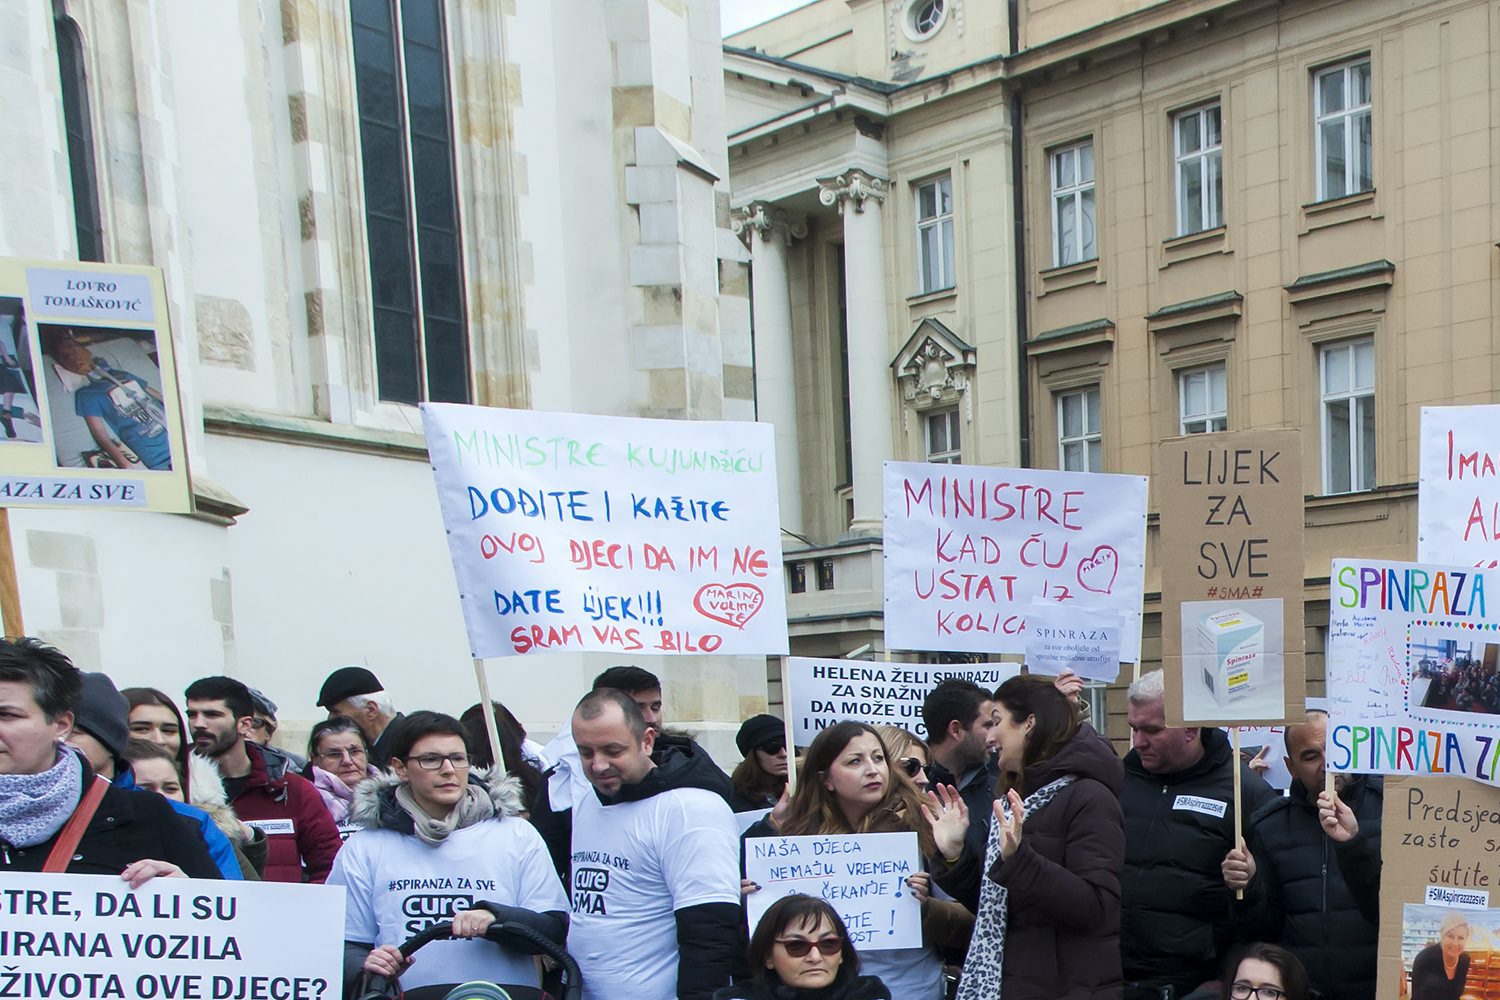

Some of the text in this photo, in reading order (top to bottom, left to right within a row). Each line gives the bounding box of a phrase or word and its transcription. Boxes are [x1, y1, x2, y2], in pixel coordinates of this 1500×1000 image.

[67, 279, 118, 293] LOVRO
[44, 295, 143, 312] TOMAŠKOVIĆ
[453, 430, 609, 467] MINISTRE
[1183, 449, 1281, 486] LIJEK
[51, 483, 85, 499] ZA
[90, 484, 135, 501] SVE
[904, 475, 1085, 531] MINISTRE
[631, 494, 732, 522] KAŽITE
[1205, 494, 1252, 526] ZA
[480, 533, 769, 577] OVOJ DJECI DA IM NE
[936, 527, 1000, 565] KAD
[1197, 538, 1269, 580] SVE
[914, 569, 1076, 603] USTAT IZ
[1207, 585, 1264, 600] #SMA#
[1338, 566, 1486, 618] SPINRAZA
[493, 590, 565, 615] DATE
[510, 624, 723, 654] SRAM VAS BILO
[1036, 628, 1108, 641] SPINRAZA
[813, 666, 887, 682] HELENA
[891, 668, 928, 684] ŽELI
[831, 684, 855, 697] ZA
[811, 700, 836, 714] DA
[841, 701, 895, 717] MOŽE
[1332, 725, 1466, 775] SPINRAZA
[755, 838, 862, 858] NAŠA DJECA
[1401, 826, 1460, 849] zašto
[602, 854, 611, 865] ZA
[614, 857, 629, 870] SVE
[770, 860, 910, 880] NEMAJU VREMENA
[1429, 860, 1489, 887] šutite
[388, 878, 496, 891] #SPIRANZA ZA SVE
[576, 869, 607, 889] cure
[95, 891, 237, 921] DA LI SU
[405, 897, 470, 916] cure
[573, 892, 607, 915] SMA
[0, 931, 242, 961] IRANA VOZILA
[0, 965, 125, 999] ŽIVOTA
[136, 974, 202, 1000] OVE
